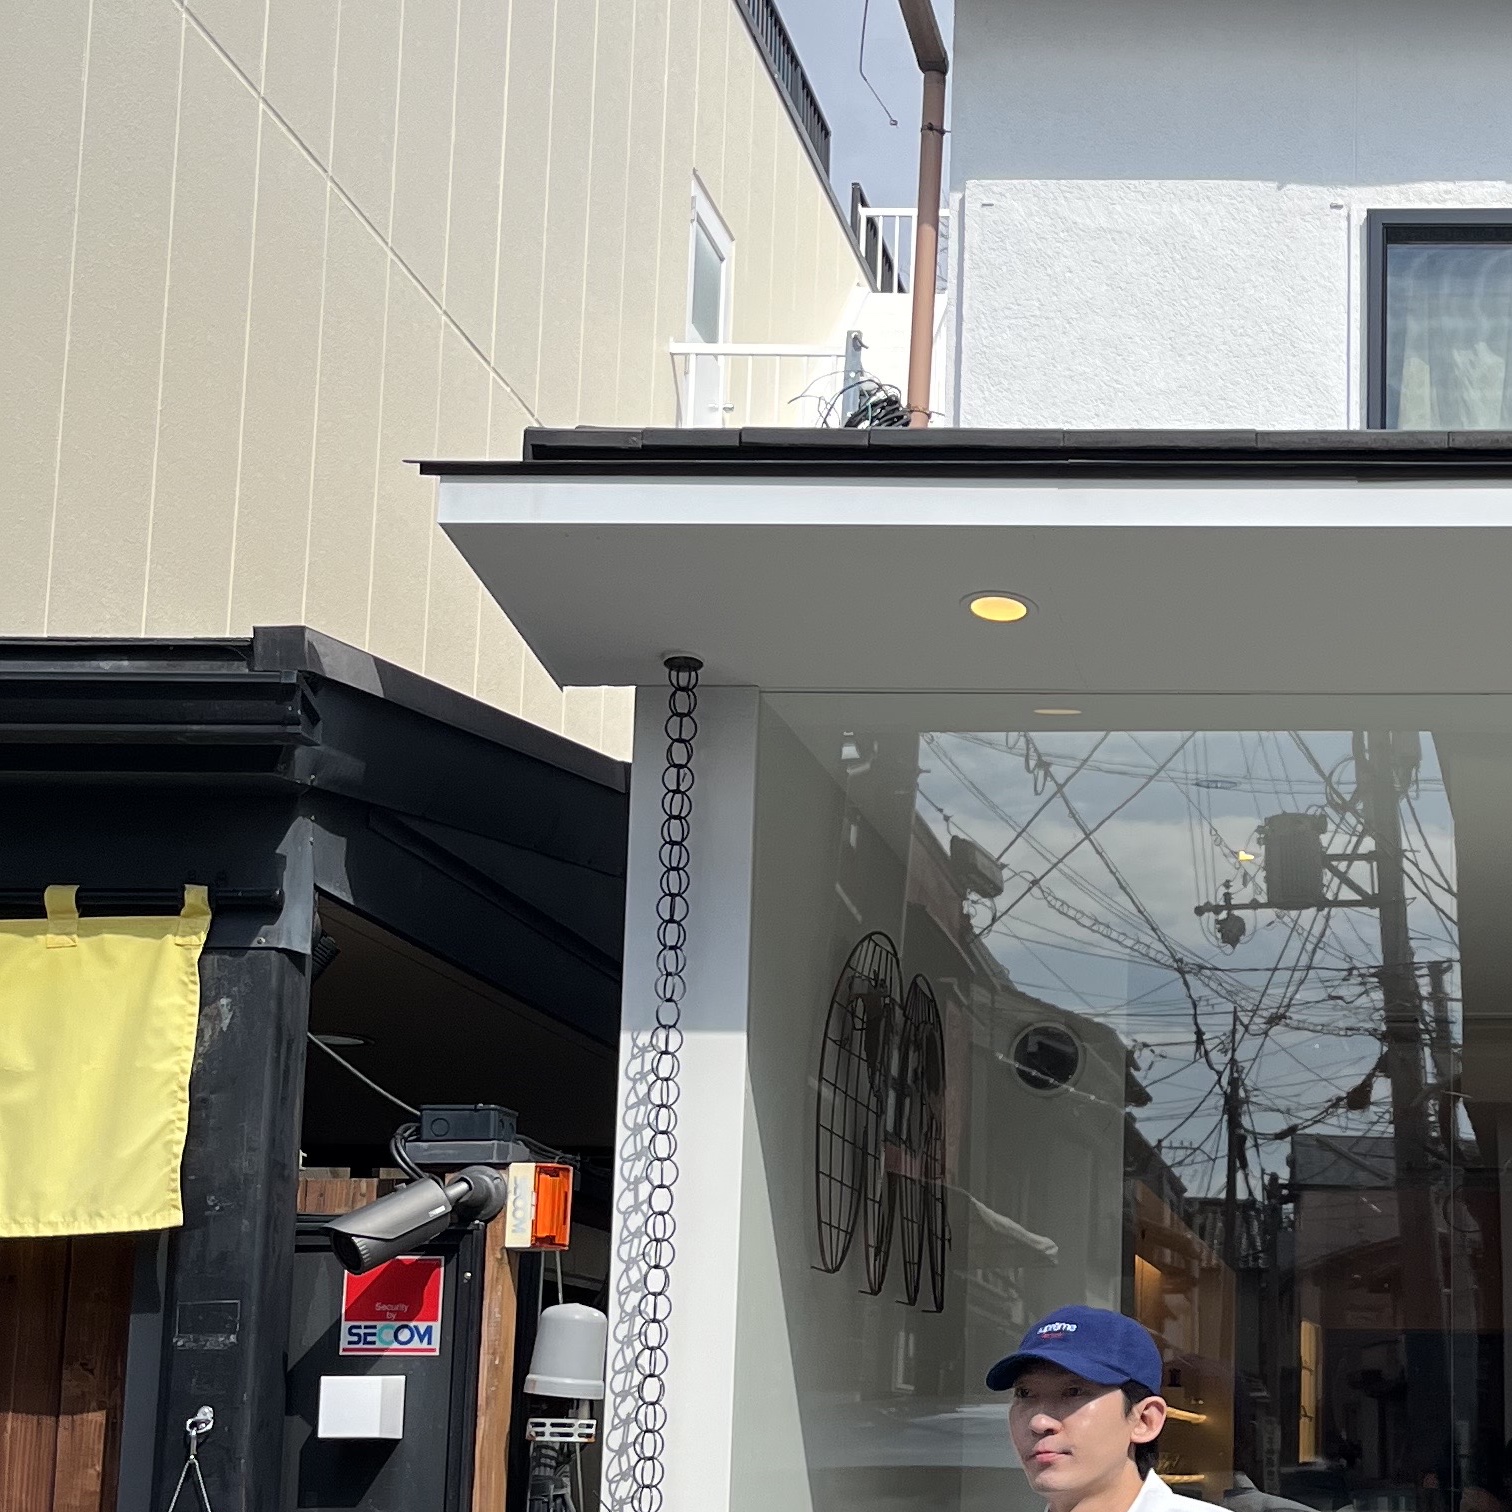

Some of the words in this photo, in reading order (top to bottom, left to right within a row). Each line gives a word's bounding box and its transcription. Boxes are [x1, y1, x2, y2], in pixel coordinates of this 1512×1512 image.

[375, 1302, 409, 1312] Security
[386, 1311, 397, 1320] by
[347, 1324, 433, 1345] SECOM
